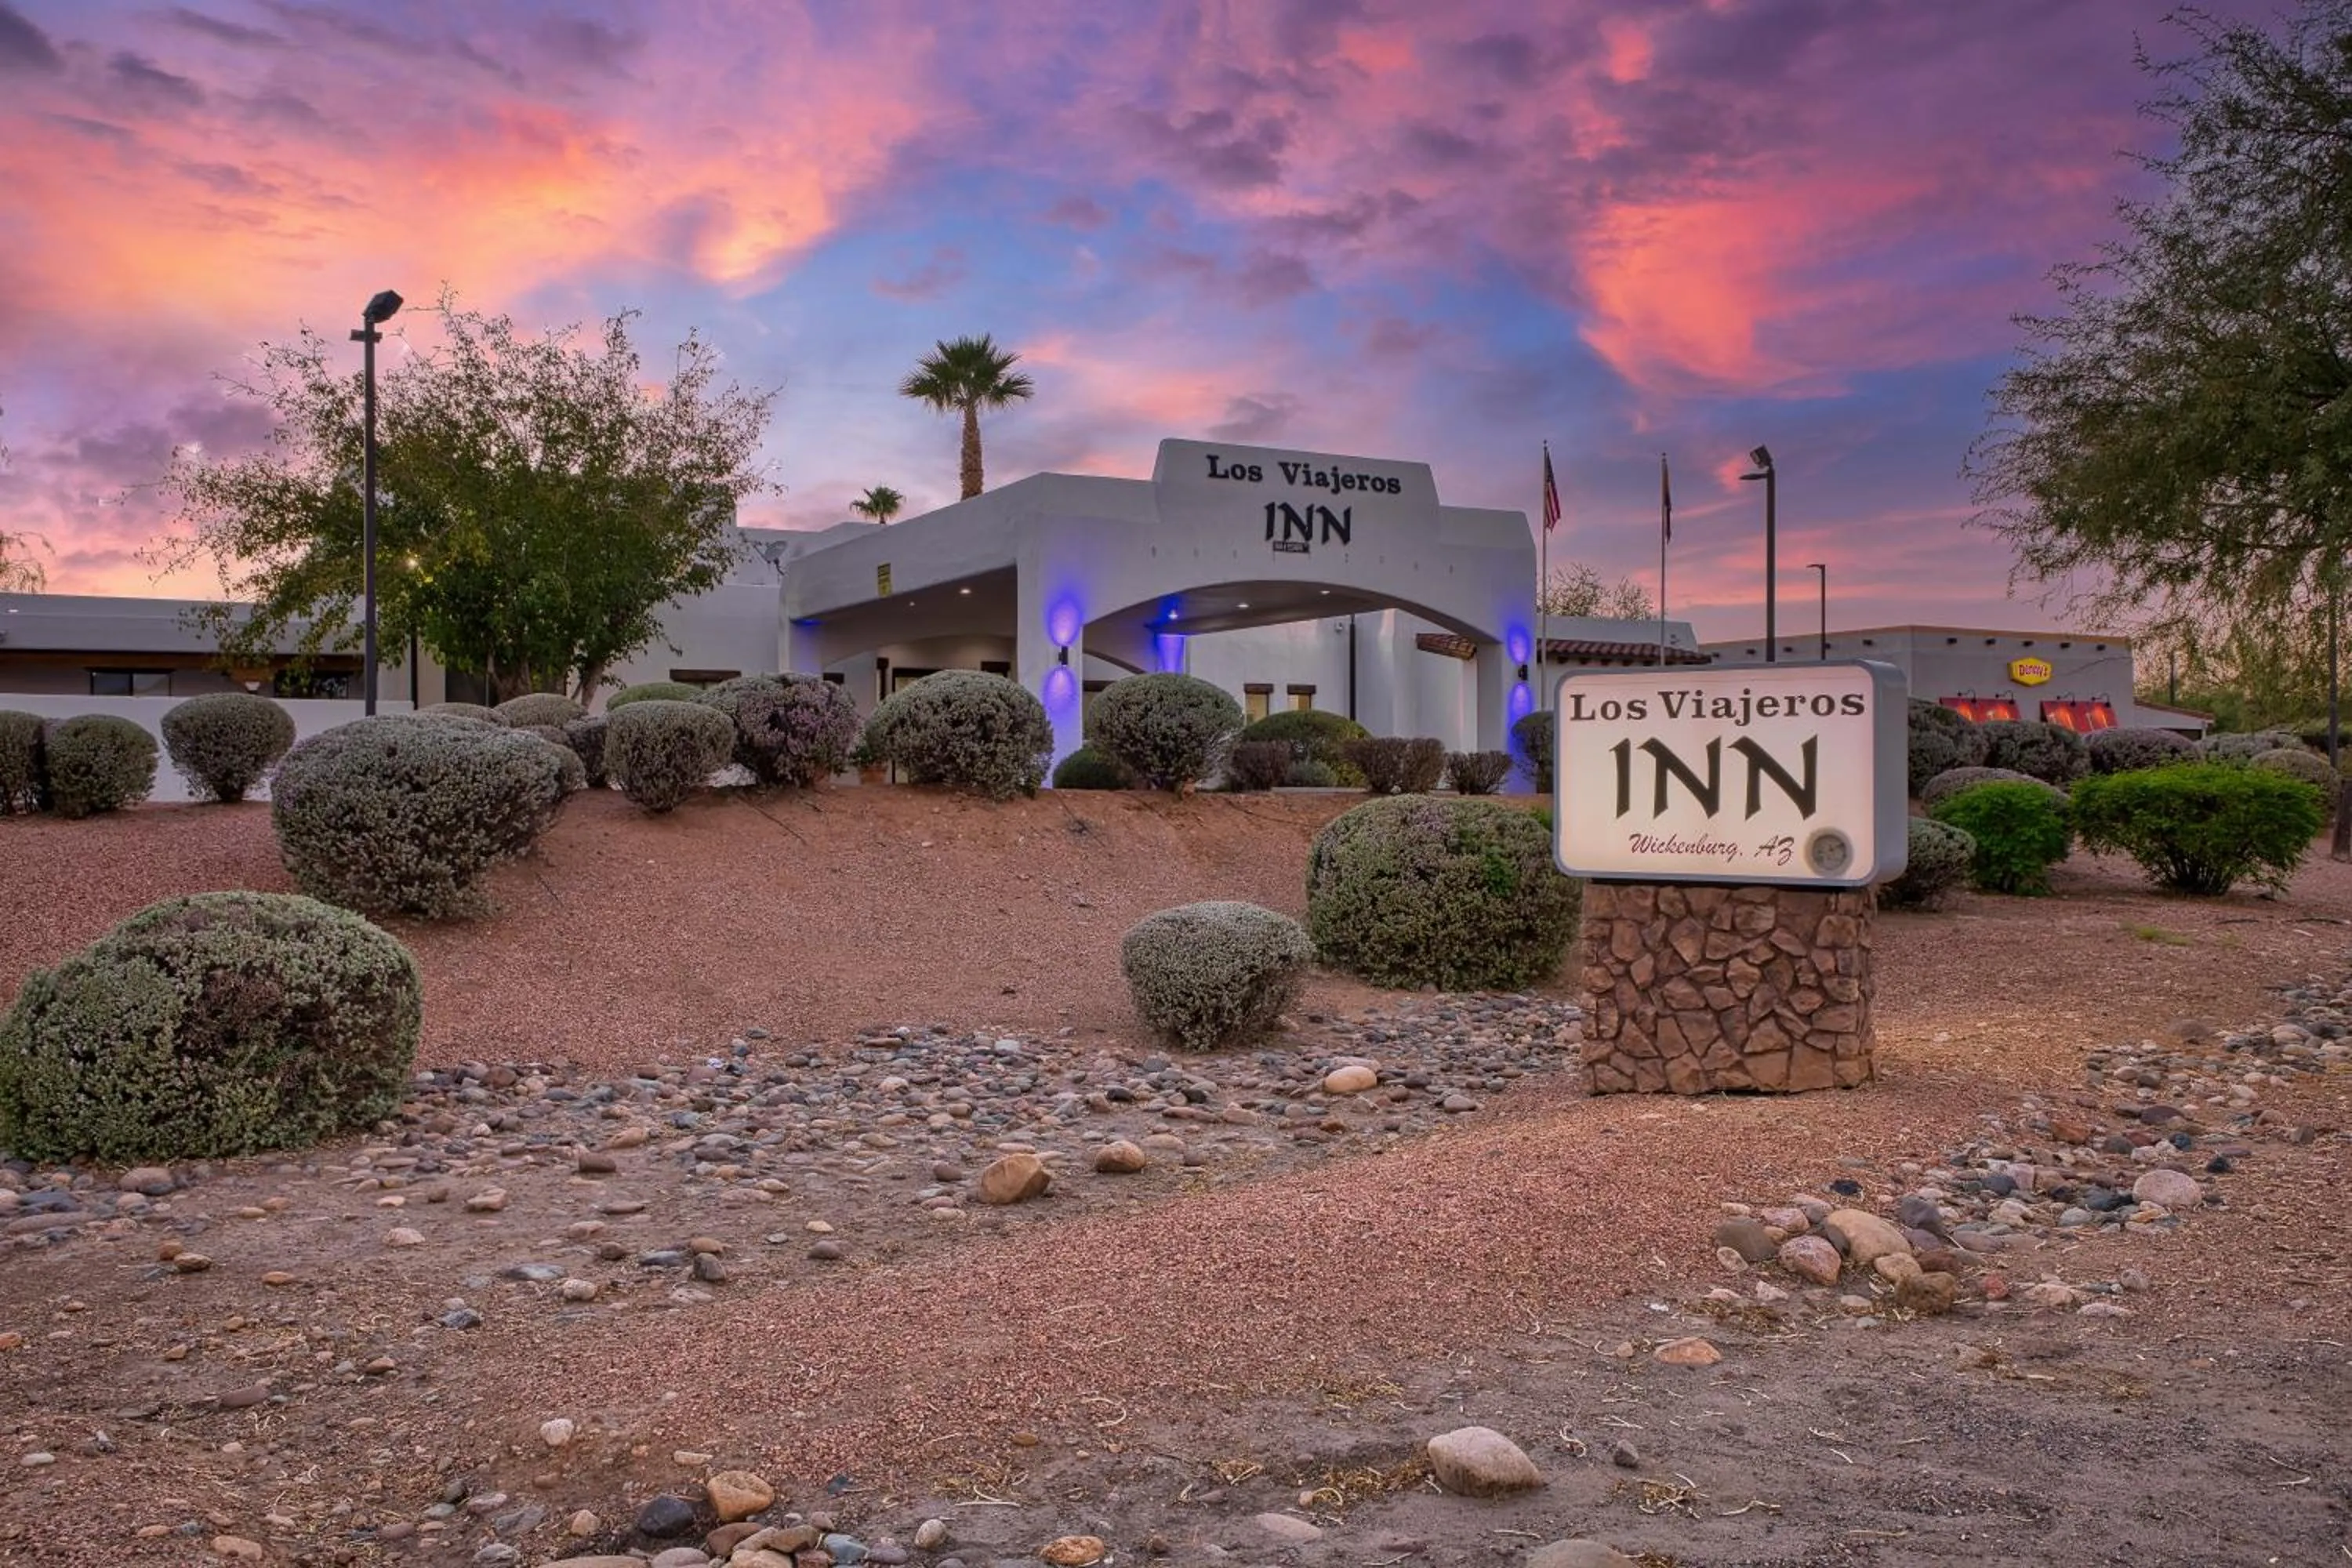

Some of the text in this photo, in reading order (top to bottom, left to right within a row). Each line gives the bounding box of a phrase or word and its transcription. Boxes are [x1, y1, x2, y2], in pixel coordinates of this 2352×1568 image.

[1206, 455, 1402, 495] Los Viajeros
[1265, 502, 1352, 545] INN
[1570, 688, 1865, 727] Los Viajeros
[1609, 735, 1818, 821] INN
[1754, 834, 1795, 866] AZ
